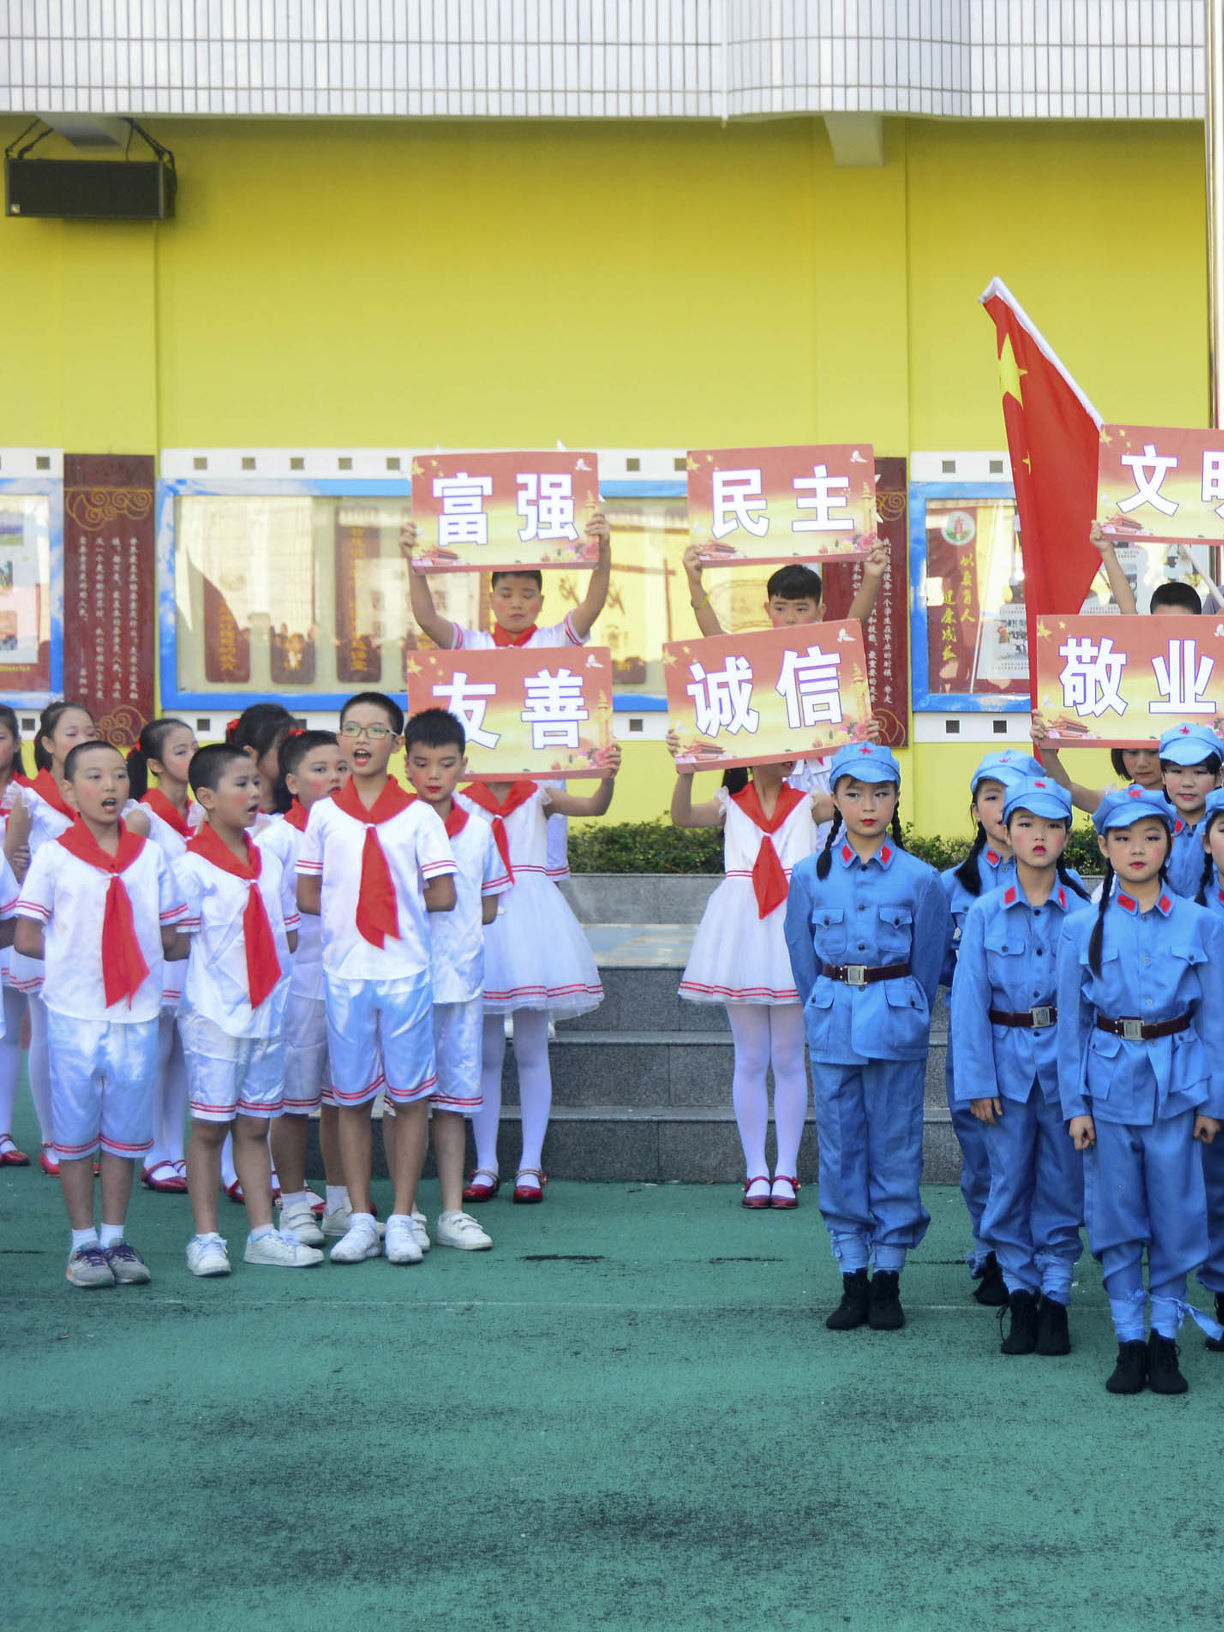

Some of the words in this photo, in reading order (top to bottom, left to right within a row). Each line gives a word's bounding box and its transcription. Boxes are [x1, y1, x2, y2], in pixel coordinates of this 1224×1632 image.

[431, 471, 579, 547] 富强
[710, 464, 855, 540] 民主
[431, 668, 590, 750] 友善
[686, 644, 844, 739] 诚信
[1058, 636, 1218, 718] 敬业
